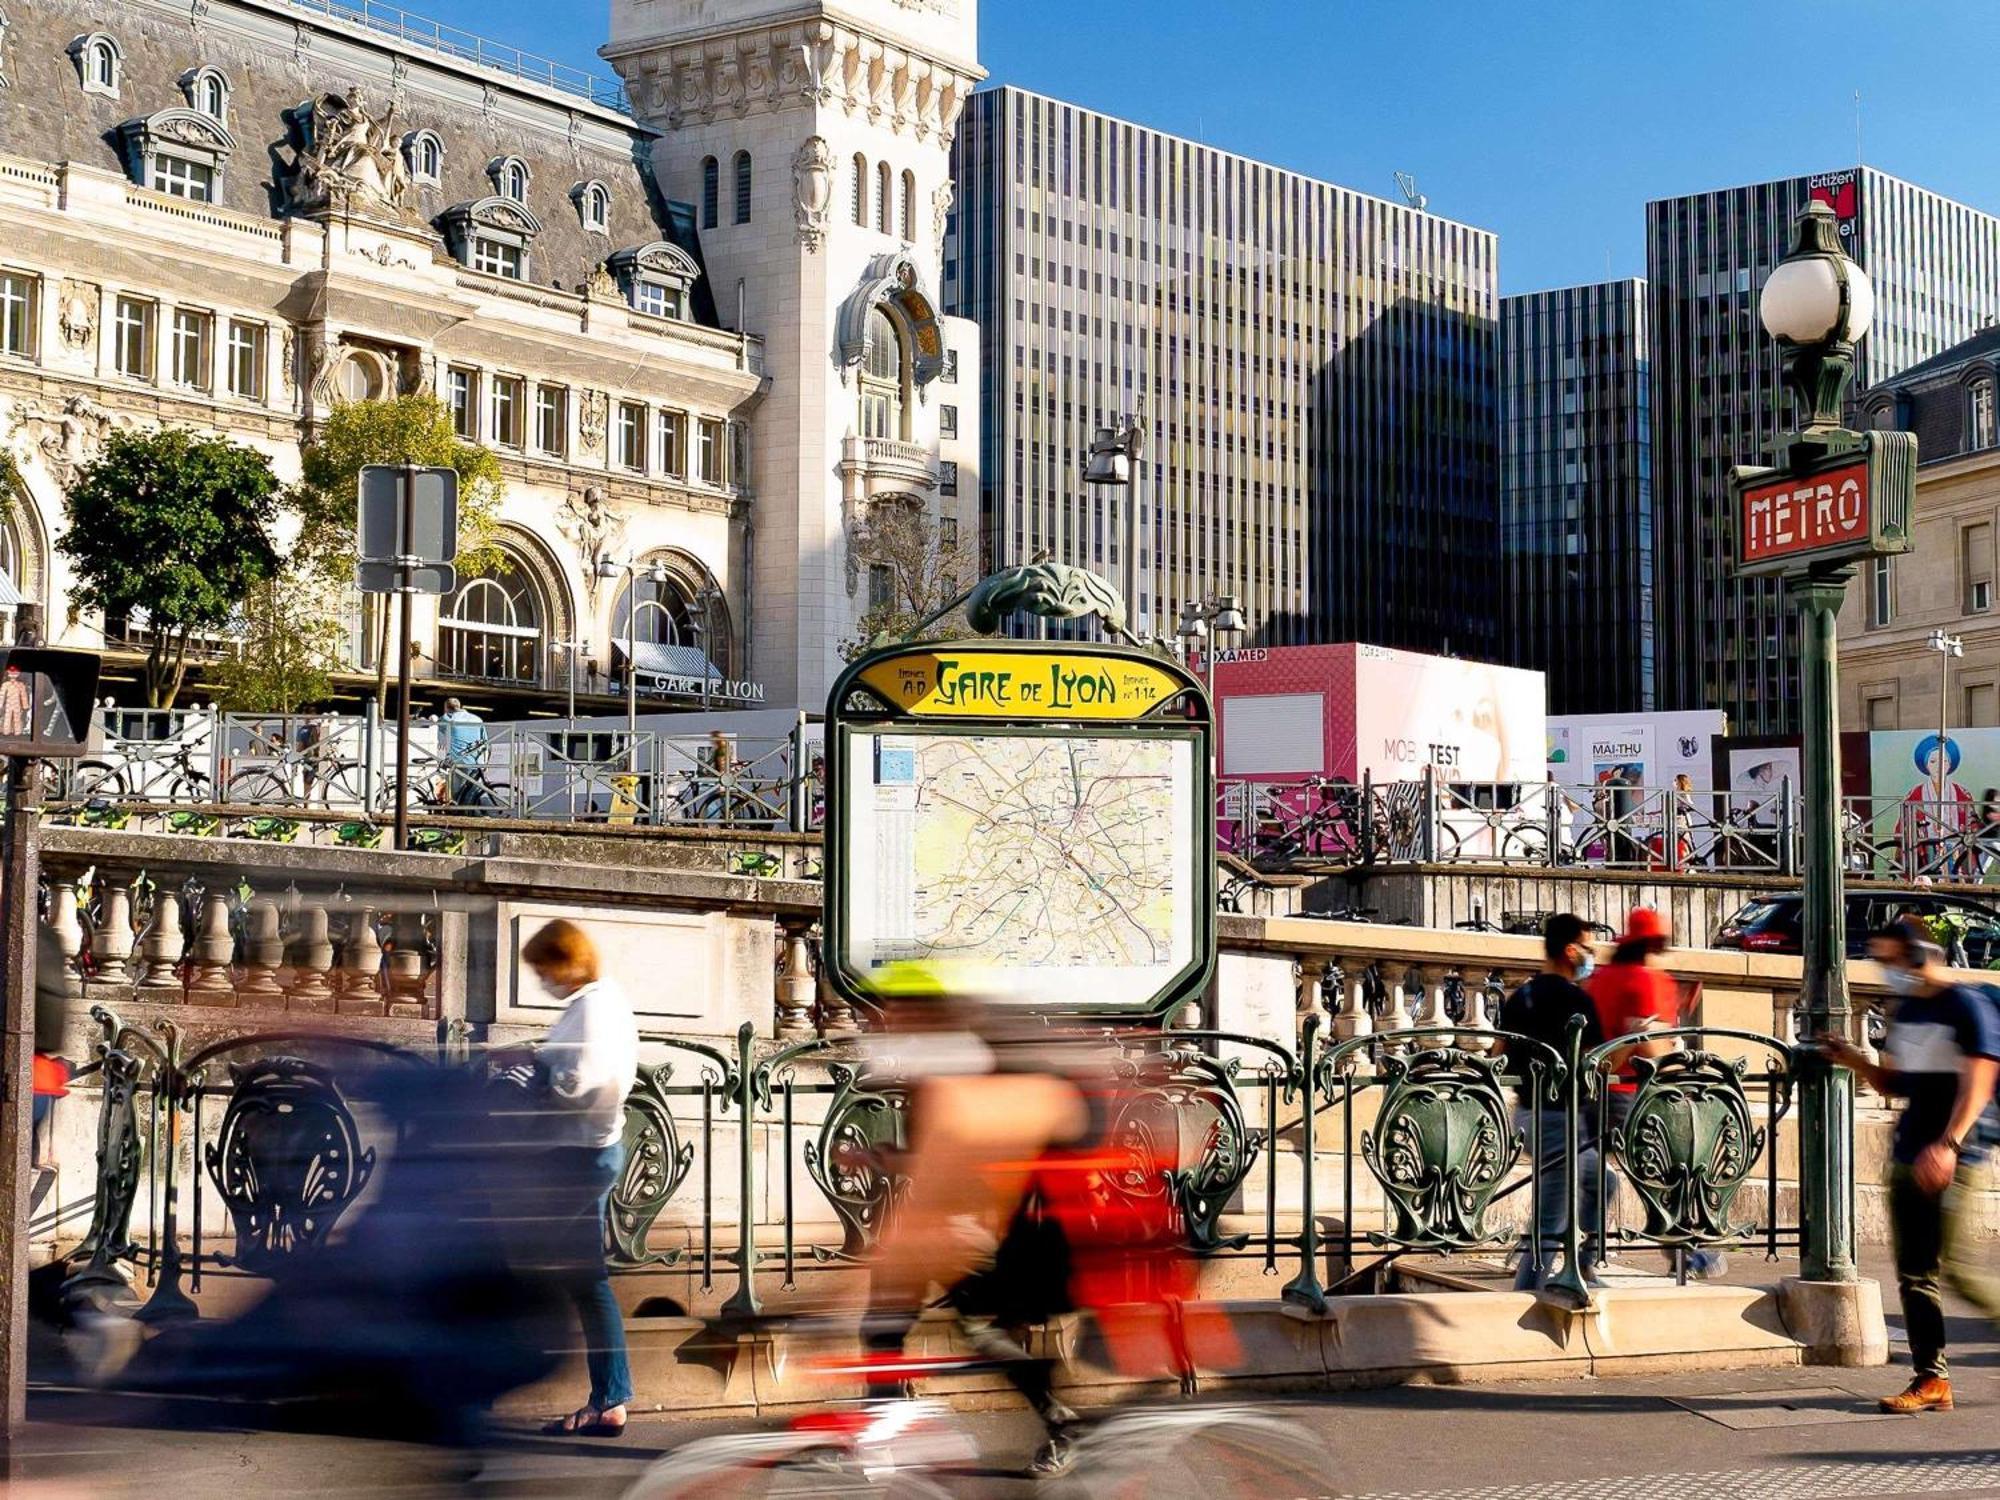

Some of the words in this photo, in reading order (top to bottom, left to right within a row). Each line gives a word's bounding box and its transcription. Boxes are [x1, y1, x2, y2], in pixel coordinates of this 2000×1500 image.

[1810, 173, 1855, 189] citizen
[1751, 479, 1860, 550] METRO
[655, 675, 695, 693] GARE
[726, 681, 764, 699] LYON
[934, 661, 1012, 707] GARE
[1021, 683, 1042, 701] DE
[1048, 664, 1116, 708] LYON
[1429, 743, 1460, 765] TEST
